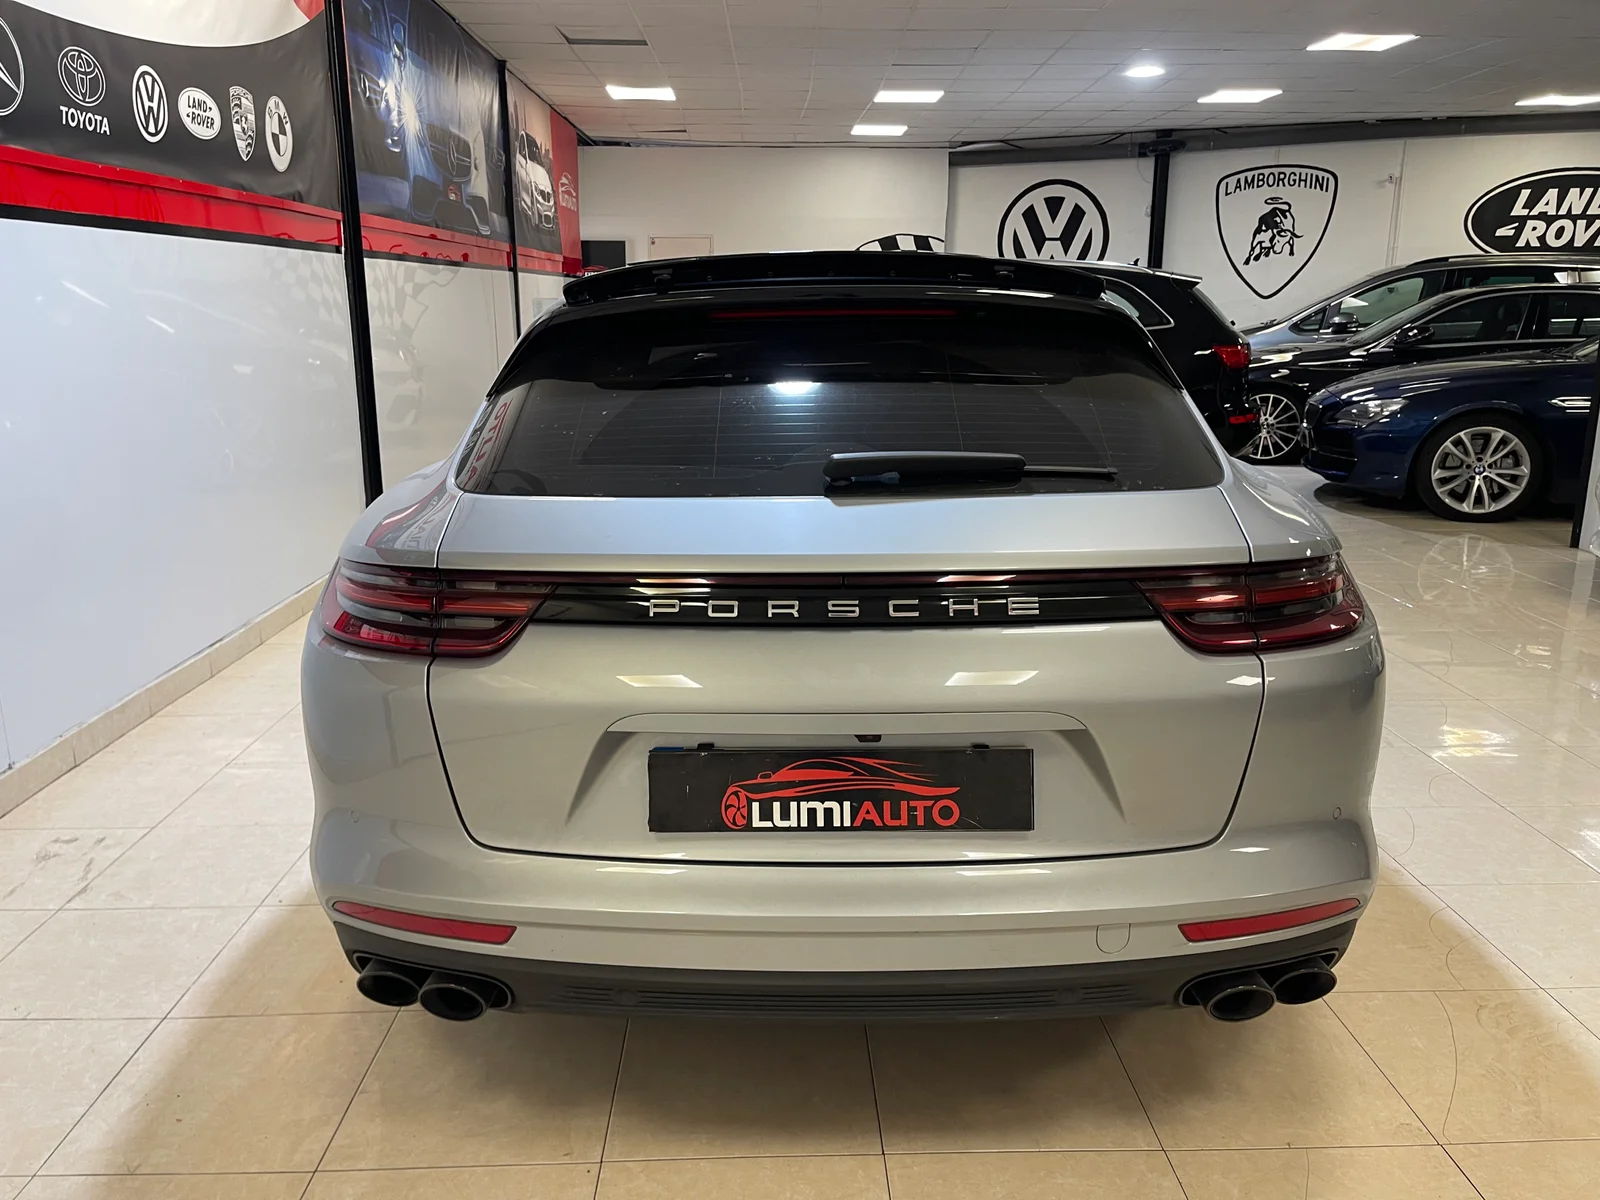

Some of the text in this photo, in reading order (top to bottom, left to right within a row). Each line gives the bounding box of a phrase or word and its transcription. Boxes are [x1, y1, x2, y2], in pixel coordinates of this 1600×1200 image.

[187, 95, 208, 112] LAND
[59, 105, 111, 136] TOYOTA
[190, 114, 215, 131] ROVER
[1224, 171, 1330, 197] LAMBORGHINI
[1514, 218, 1600, 248] ROV
[648, 596, 1041, 618] PORSCHE
